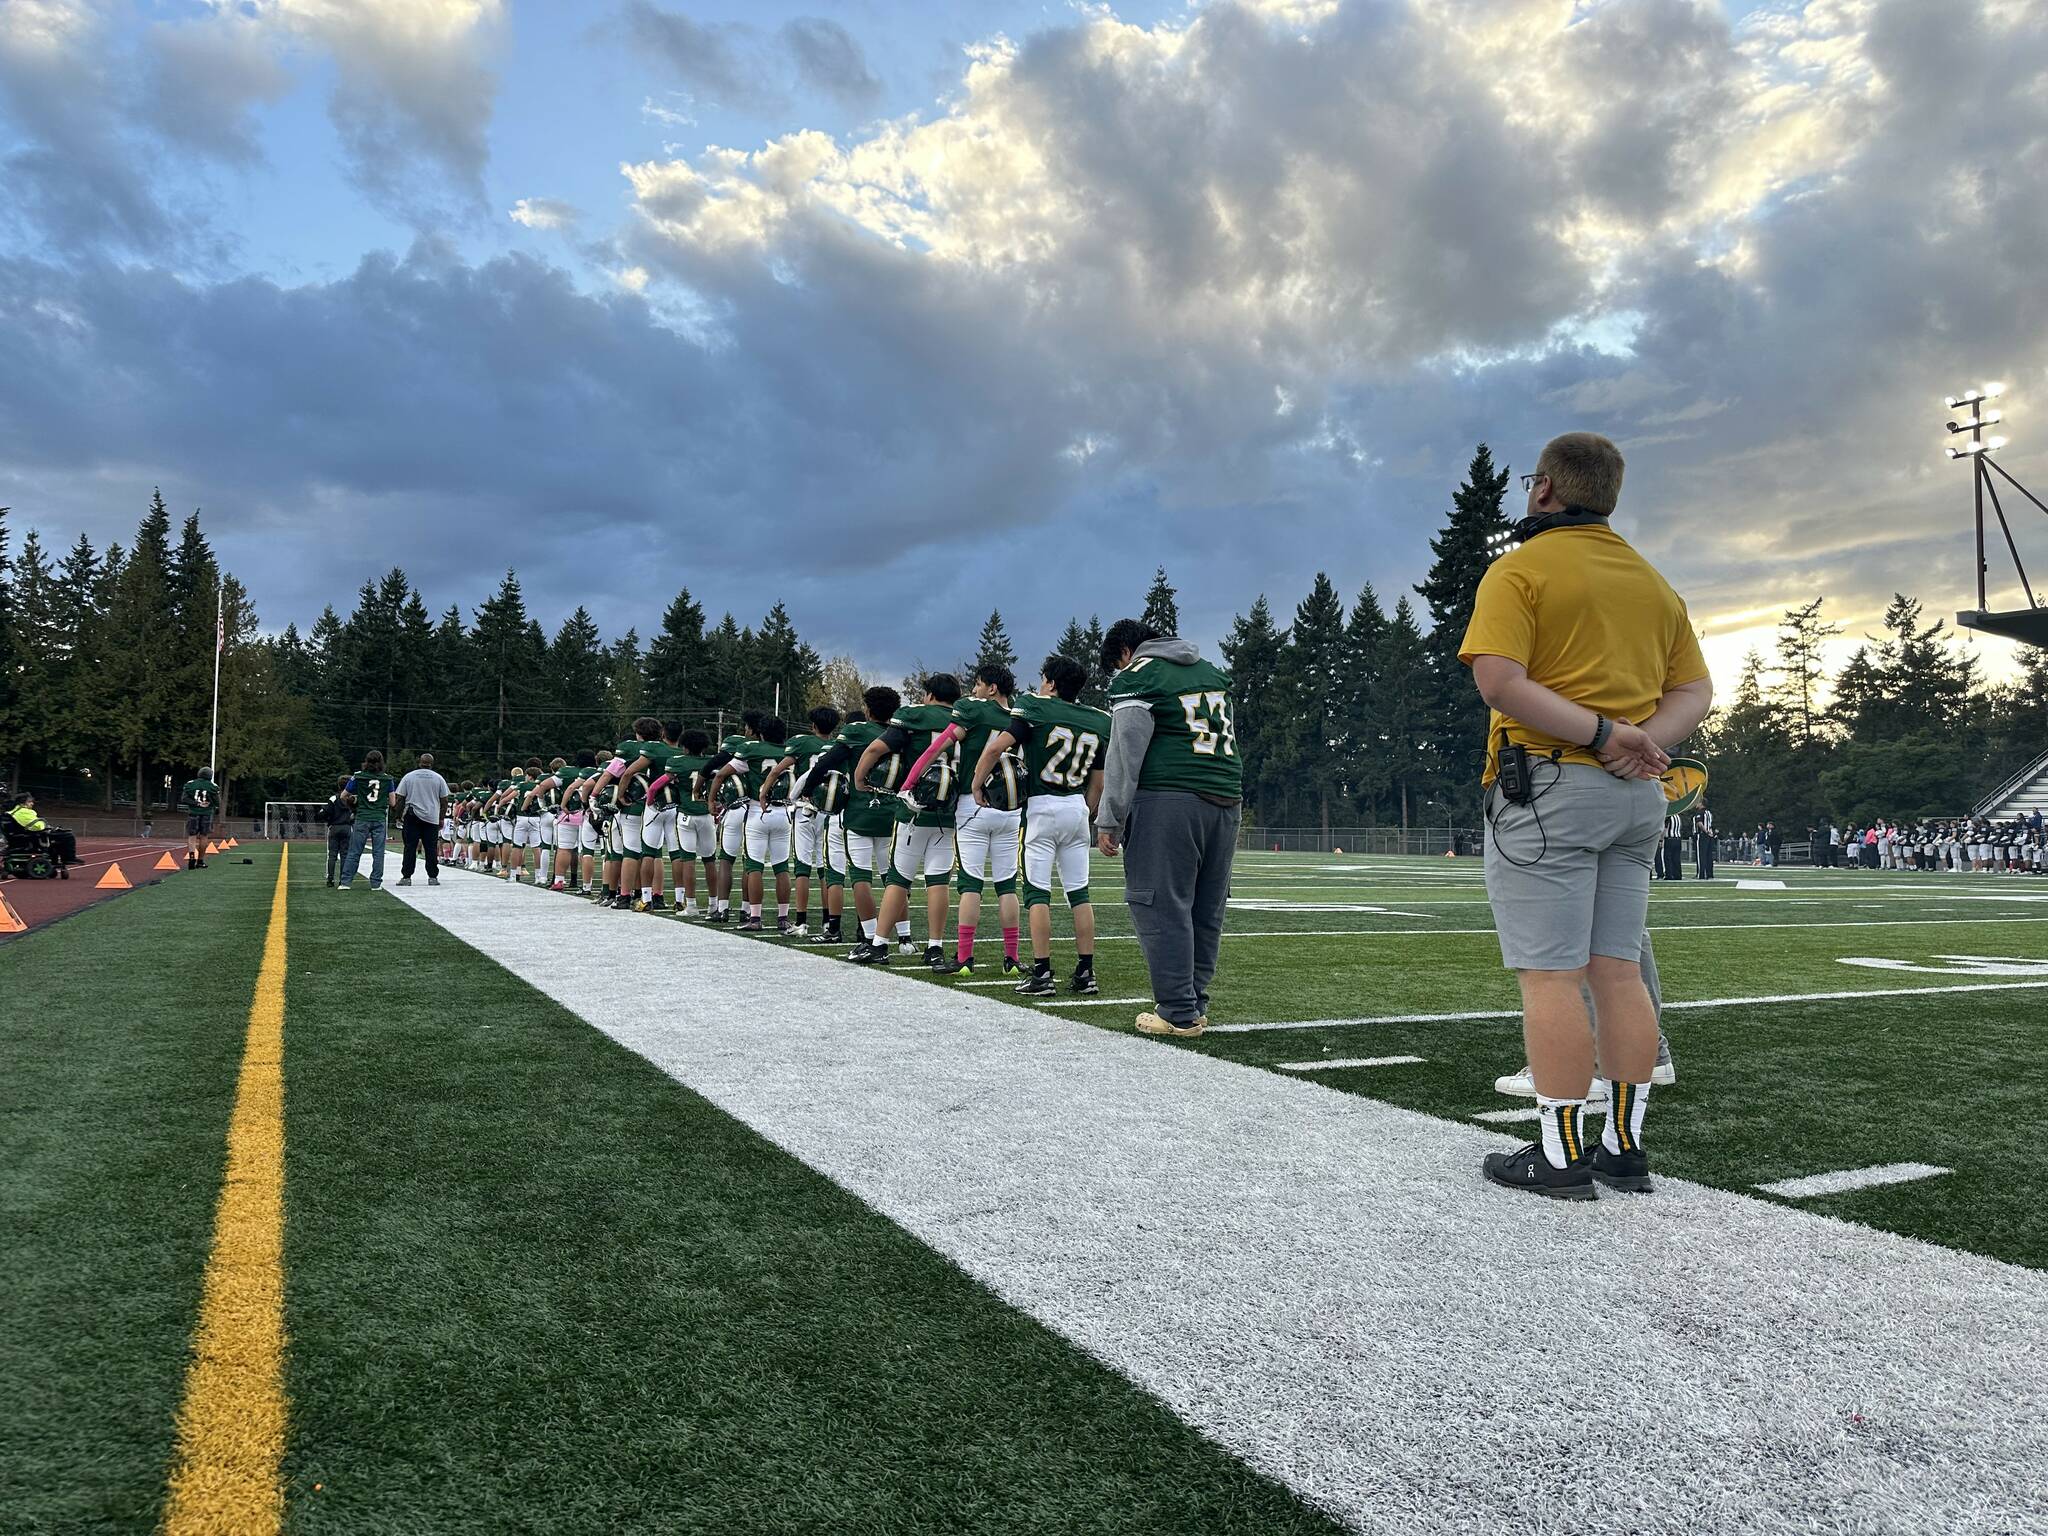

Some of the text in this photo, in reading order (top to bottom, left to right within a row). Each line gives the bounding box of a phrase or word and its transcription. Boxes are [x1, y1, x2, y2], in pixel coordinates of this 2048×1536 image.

[1178, 691, 1234, 756] 57
[1040, 726, 1100, 787] 20
[366, 779, 380, 802] 3
